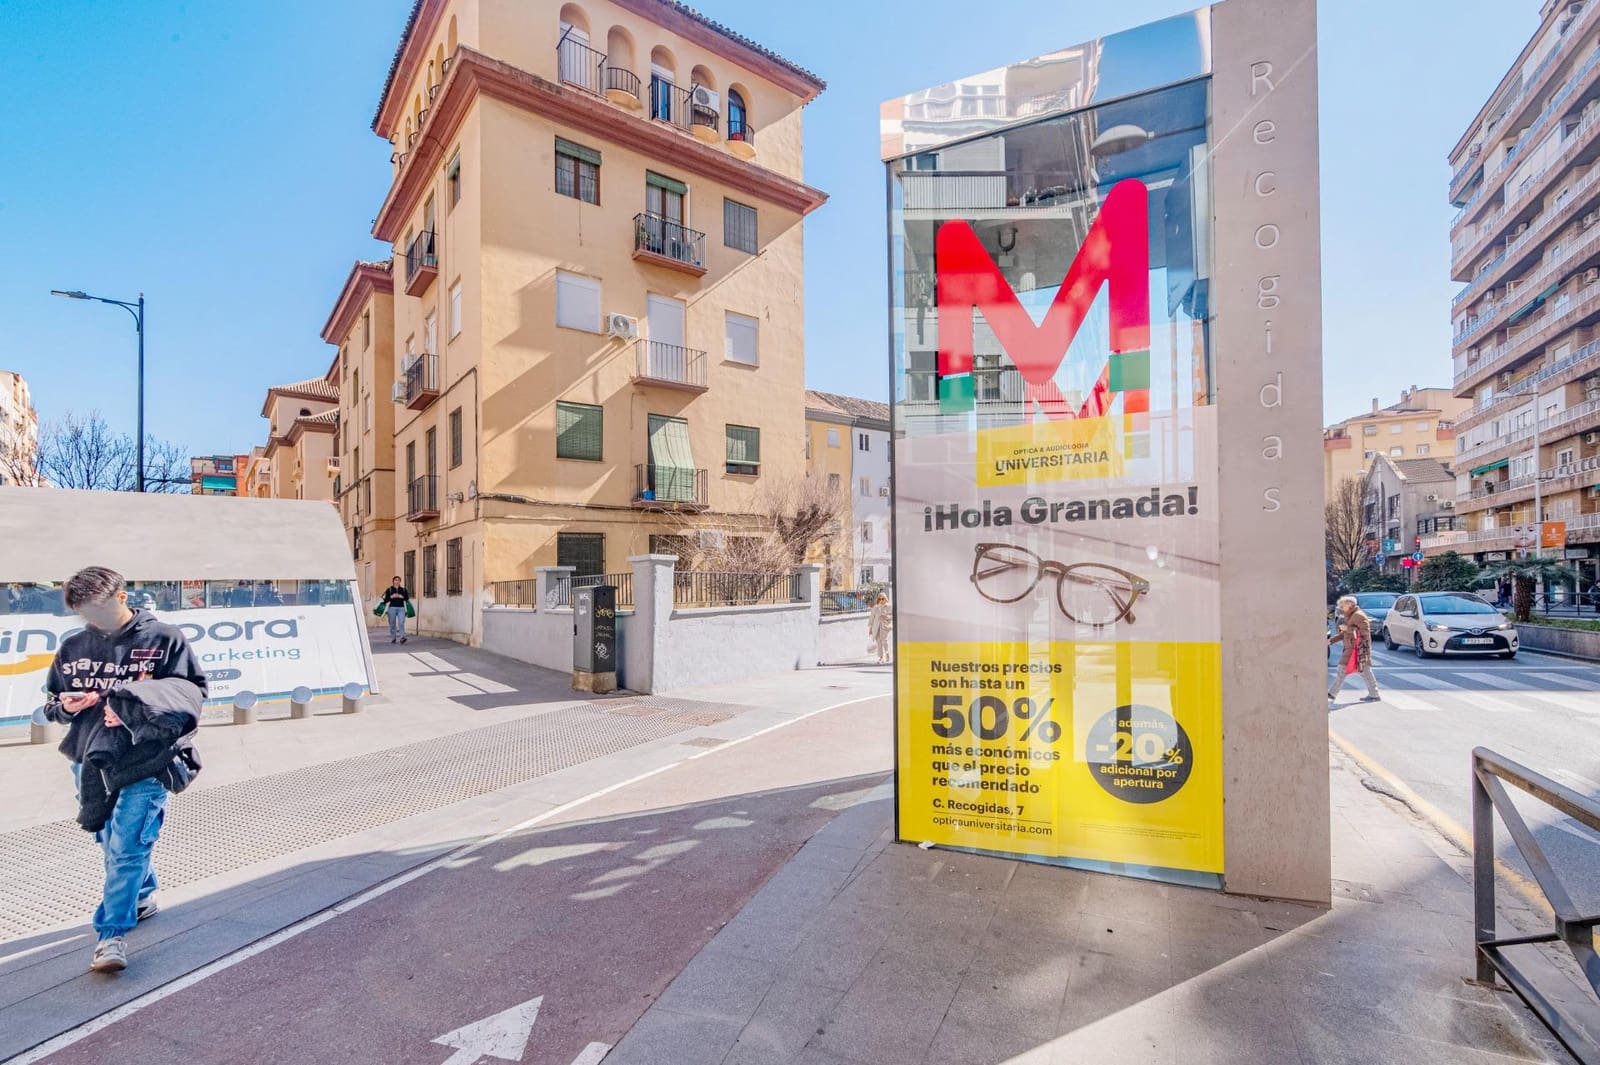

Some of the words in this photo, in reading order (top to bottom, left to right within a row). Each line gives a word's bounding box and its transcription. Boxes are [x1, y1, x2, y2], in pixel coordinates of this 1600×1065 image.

[1250, 60, 1284, 513] Recogidas
[995, 450, 1110, 474] UNIVERSITARIA
[924, 499, 1013, 533] ¡Hola
[1020, 485, 1199, 526] Granada!
[199, 646, 301, 662] arketing
[931, 660, 1000, 674] Nuestros
[1002, 660, 1063, 676] precios
[71, 677, 83, 689] &
[931, 678, 957, 689] son
[960, 676, 1002, 690] hasta
[1005, 679, 1025, 690] un
[931, 694, 1062, 743] 50%
[932, 743, 962, 756] más
[965, 746, 1061, 761] económicos
[1095, 731, 1184, 765] -20%
[932, 761, 959, 773] que
[963, 760, 976, 772] el
[980, 763, 1030, 777] precio
[1100, 764, 1153, 777] adicional
[1156, 769, 1178, 779] por
[1113, 777, 1164, 789] apertura
[932, 798, 945, 809] C.
[947, 799, 1014, 816] Recogidas,
[1016, 805, 1025, 816] 7
[932, 815, 1053, 836] opticauniversitaria.com
